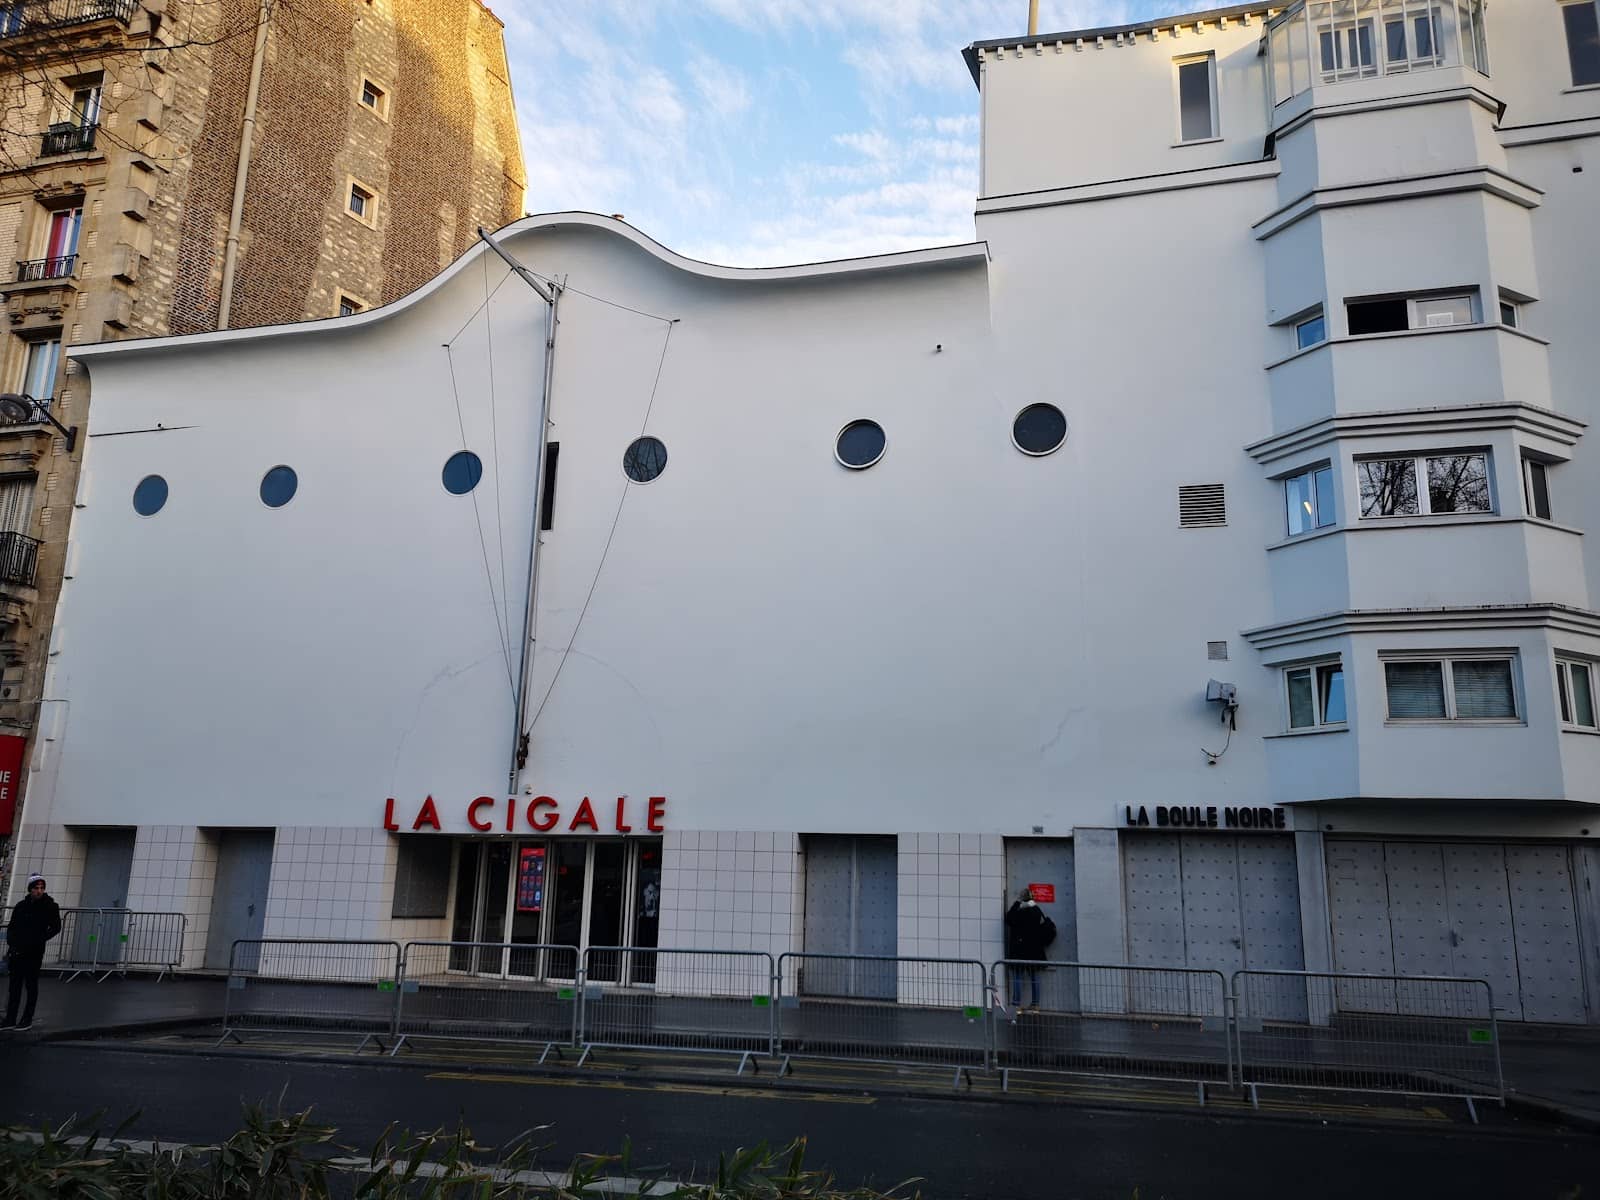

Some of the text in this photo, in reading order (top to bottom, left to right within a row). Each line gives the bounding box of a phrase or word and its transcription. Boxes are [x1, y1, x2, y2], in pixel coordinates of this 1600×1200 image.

[383, 795, 666, 832] LA CIGALE
[1125, 805, 1286, 829] LA BOULE NOIRE
